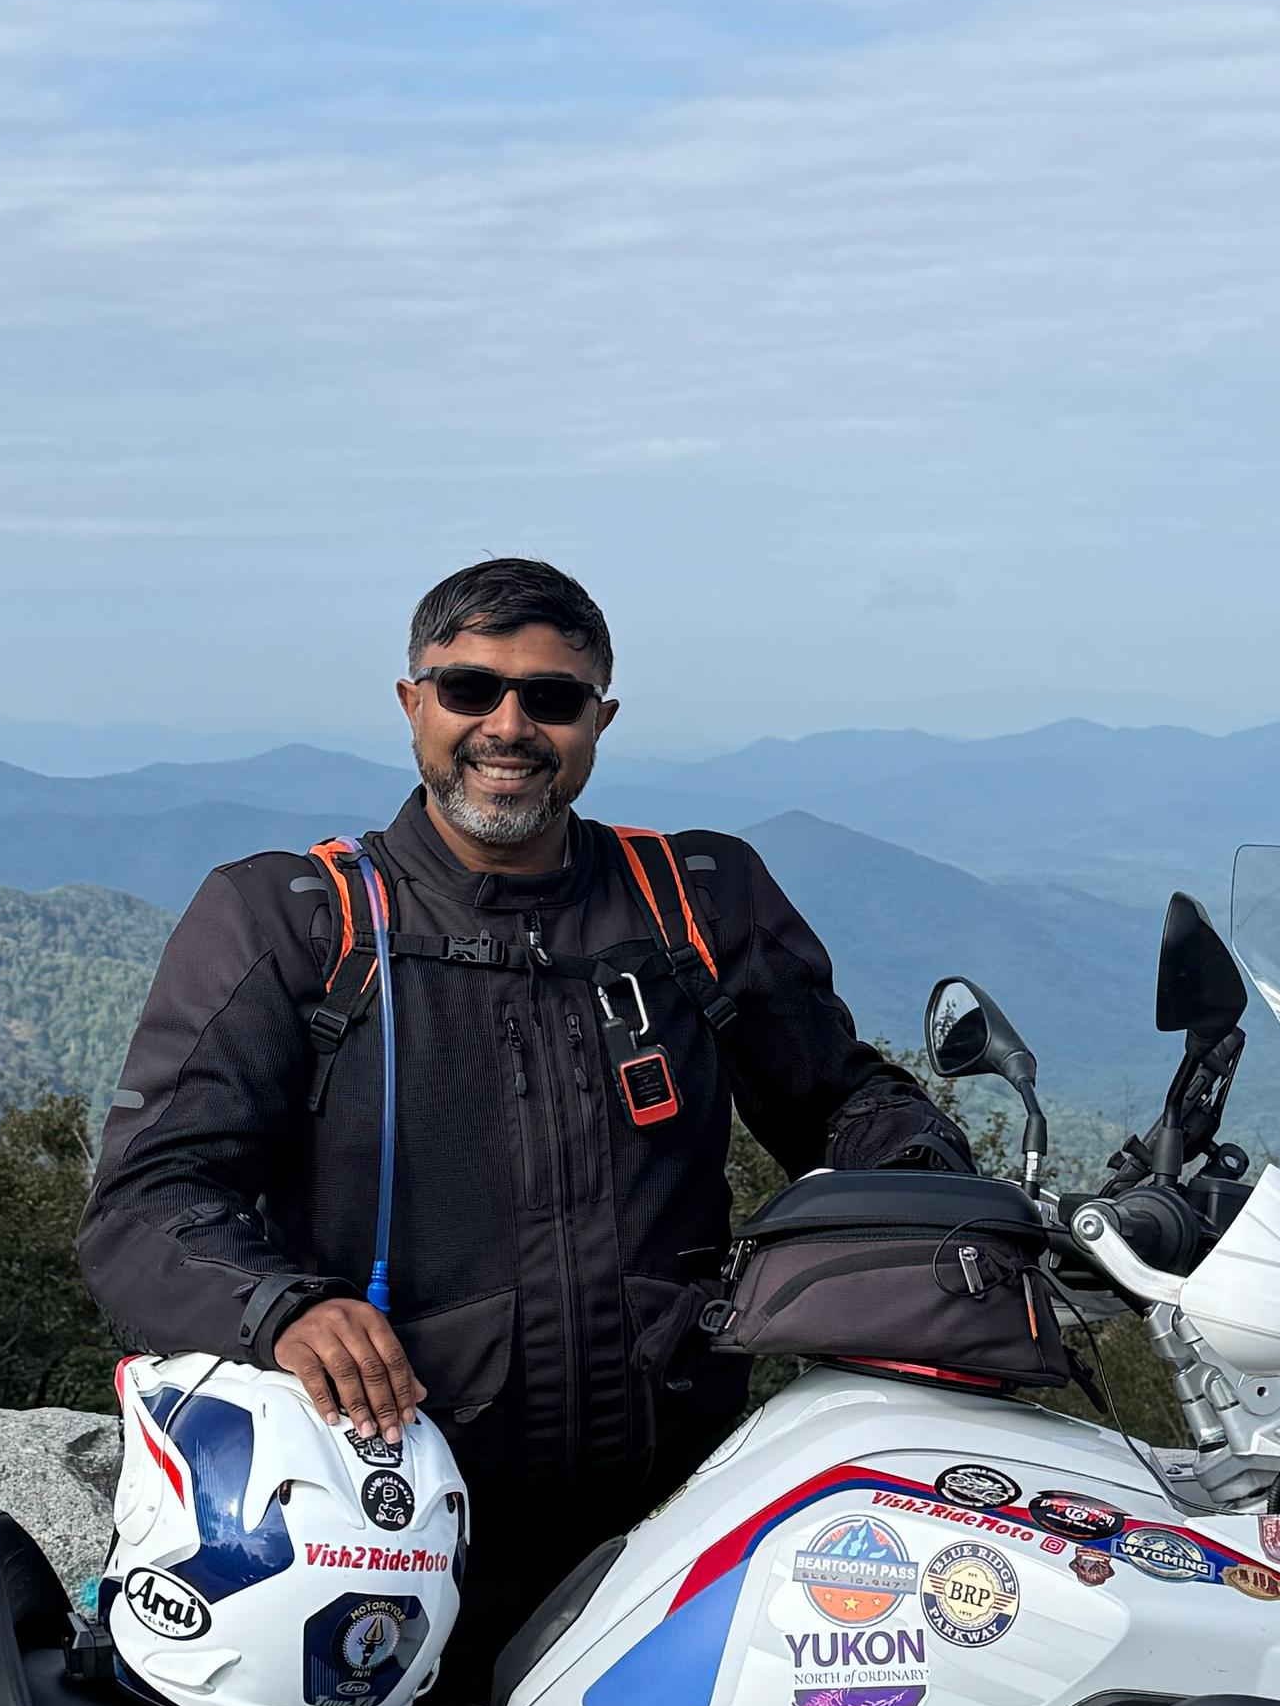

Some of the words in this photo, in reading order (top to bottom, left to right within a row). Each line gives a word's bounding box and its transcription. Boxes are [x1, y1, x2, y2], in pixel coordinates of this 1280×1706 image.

[872, 1492, 1034, 1542] Vish2RideMoto
[795, 1556, 878, 1574] BEARTOOTH
[880, 1563, 916, 1580] PASS
[932, 1545, 973, 1574] BLUE
[978, 1547, 1014, 1592] RIDGE
[1120, 1543, 1209, 1574] WYOMING
[128, 1575, 197, 1628] Arai
[948, 1580, 991, 1608] BRP
[351, 1601, 406, 1622] MOTORCYCLE
[929, 1606, 999, 1643] PARKWAY
[785, 1629, 926, 1668] YUKON
[794, 1672, 840, 1685] NORTH
[844, 1669, 858, 1685] of
